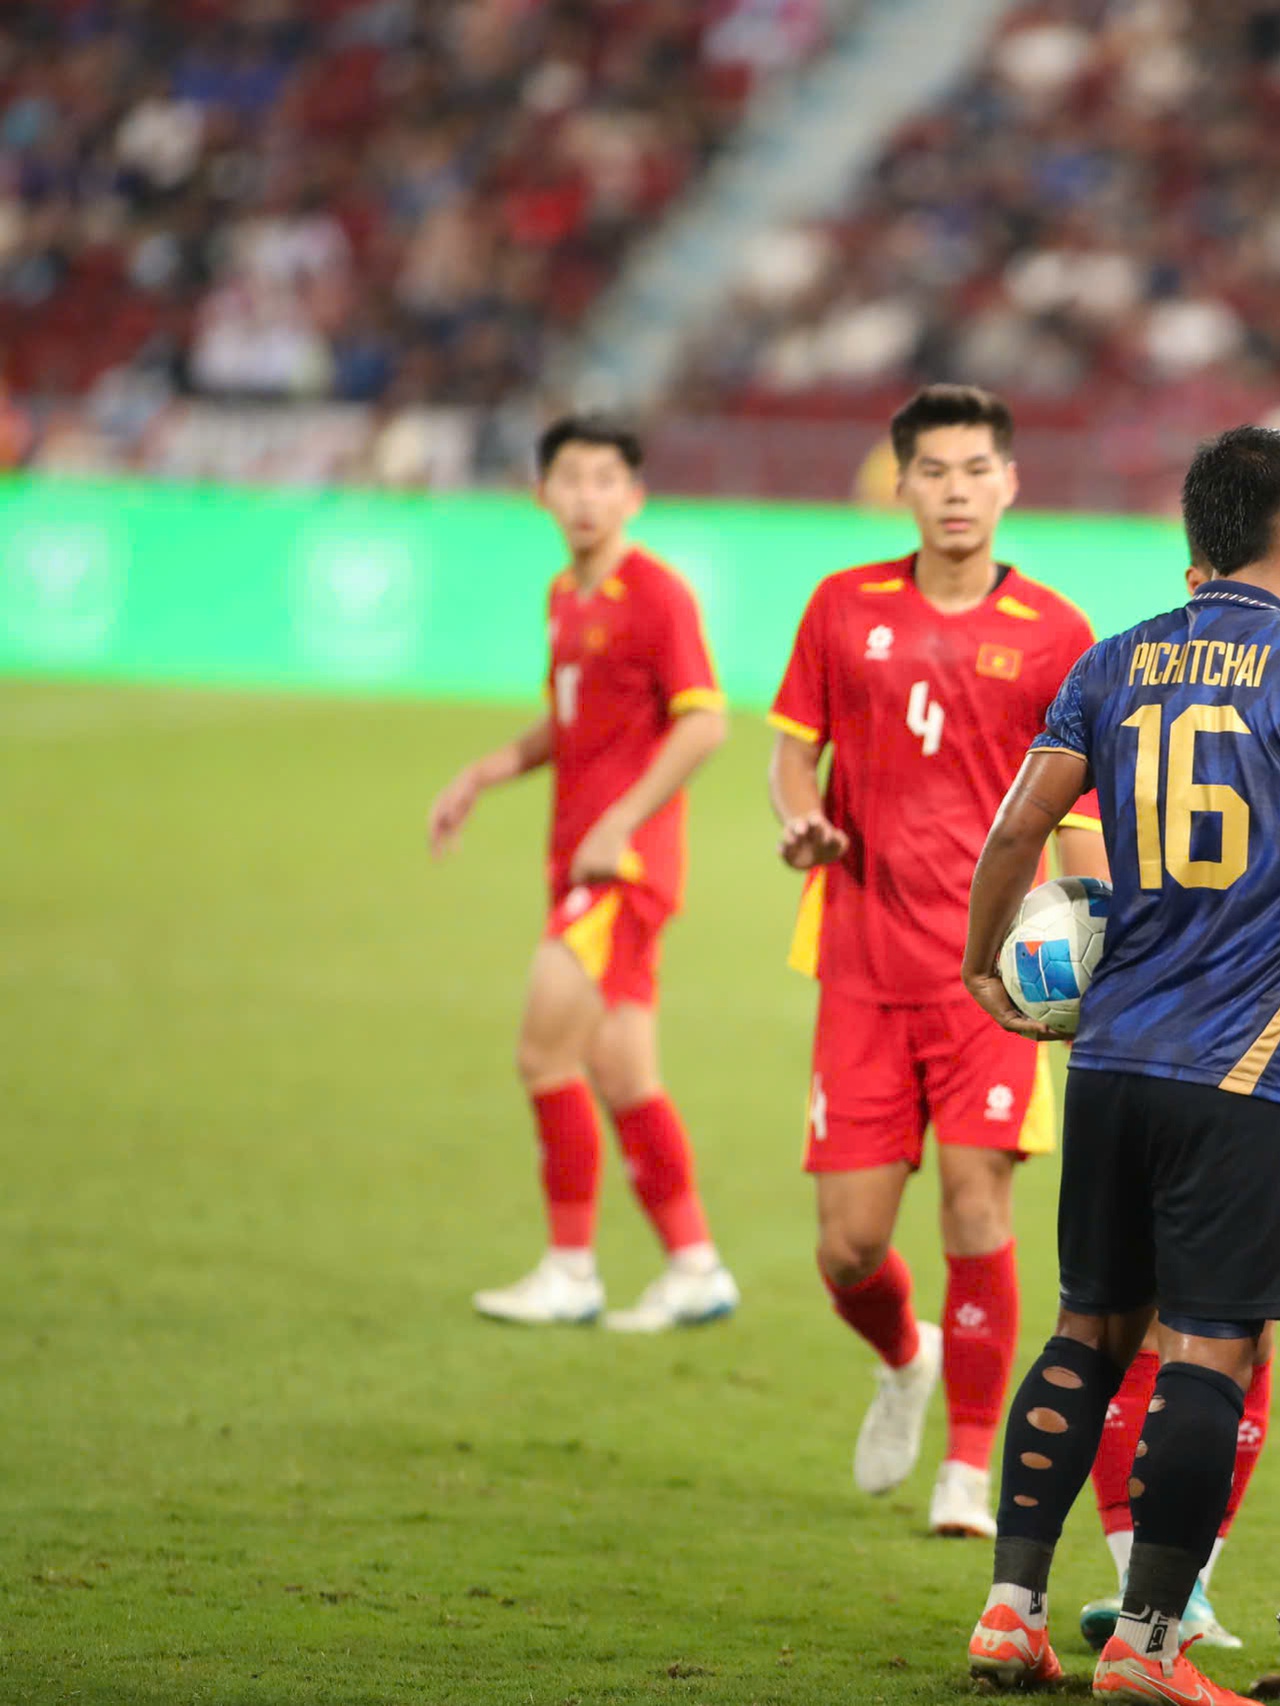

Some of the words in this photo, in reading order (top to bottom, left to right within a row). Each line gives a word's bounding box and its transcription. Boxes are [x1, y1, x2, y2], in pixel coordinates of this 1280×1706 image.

[1128, 639, 1271, 687] PICHITCHAI
[906, 680, 945, 757] 4
[1120, 704, 1252, 890] 16
